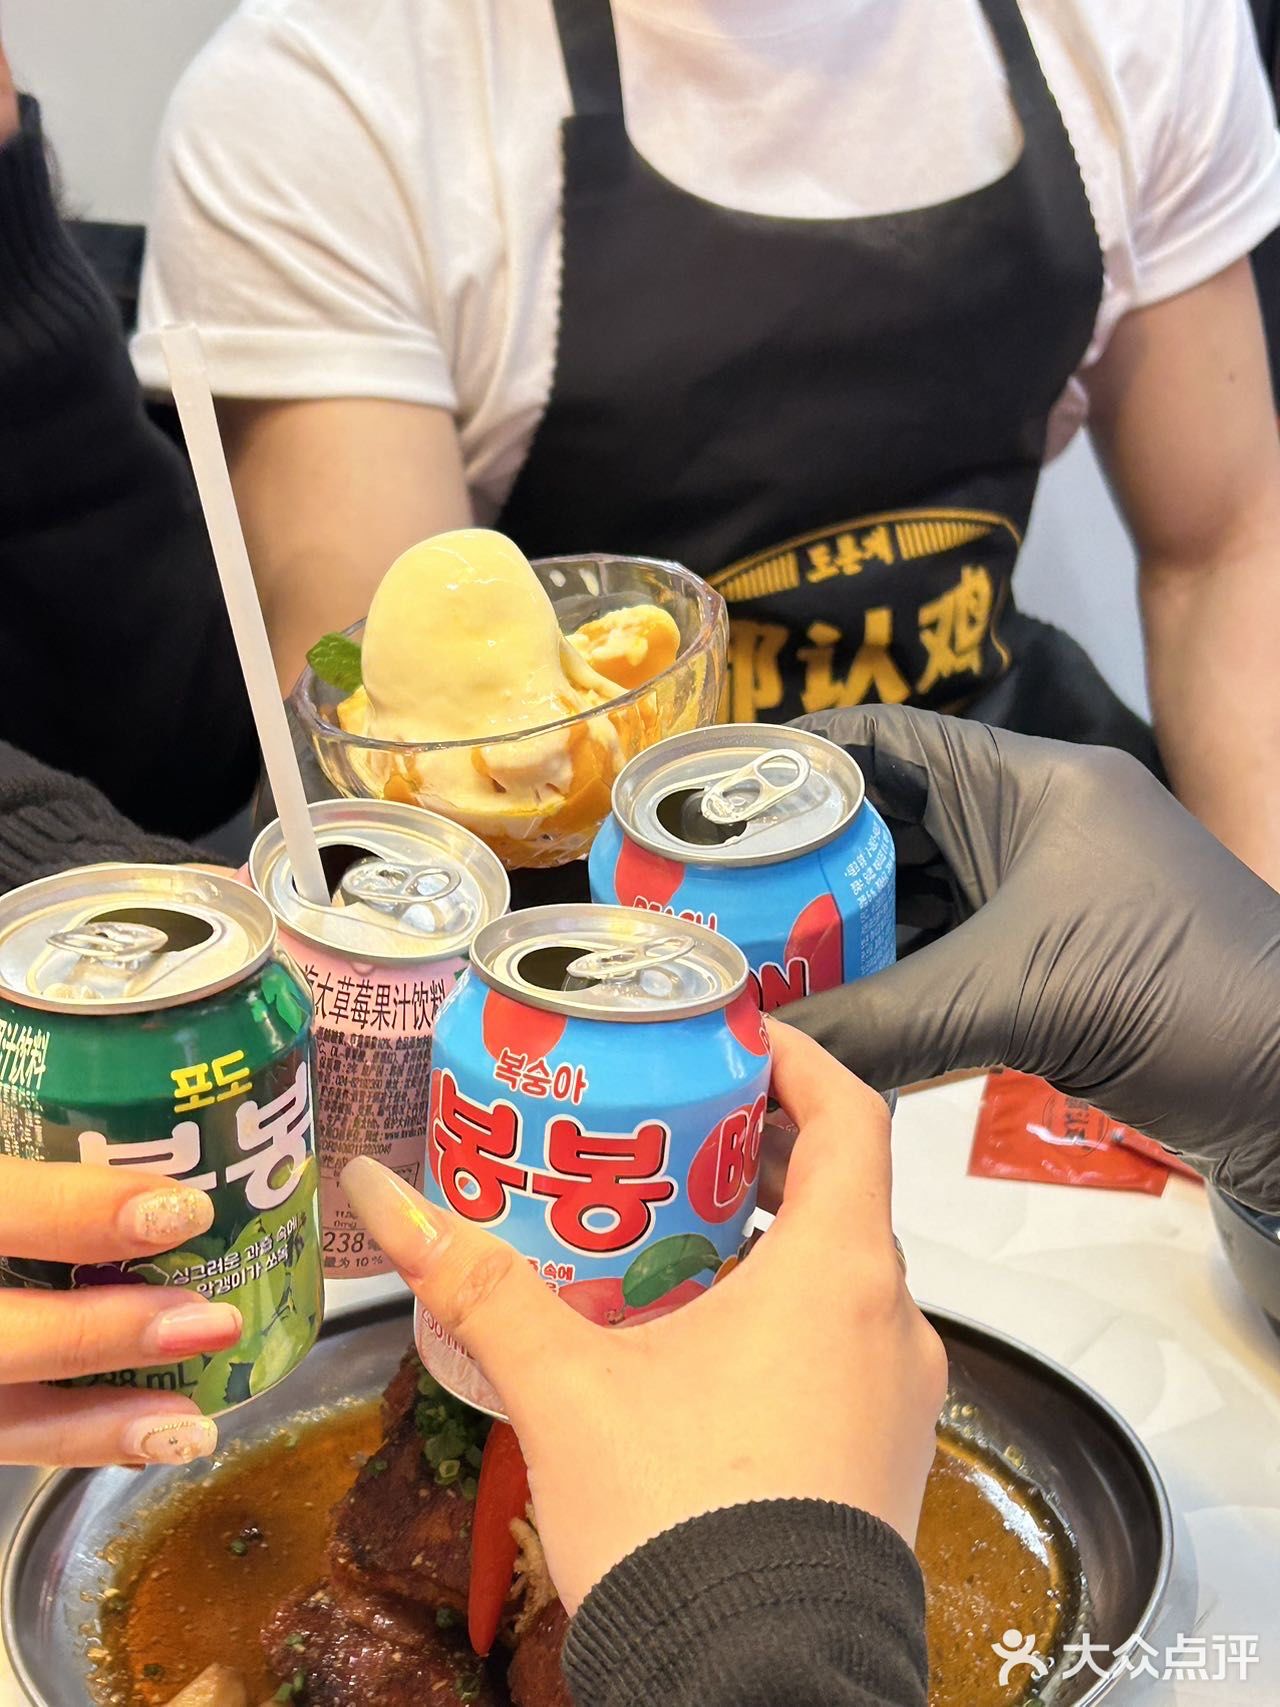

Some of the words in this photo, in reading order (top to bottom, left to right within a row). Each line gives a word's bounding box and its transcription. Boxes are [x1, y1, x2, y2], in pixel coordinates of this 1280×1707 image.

[0, 1018, 50, 1091] 汁饮料
[171, 1049, 252, 1114] 포도
[493, 1046, 591, 1105] 복숭아
[431, 1070, 678, 1255] 봉봉
[323, 1231, 365, 1253] 238
